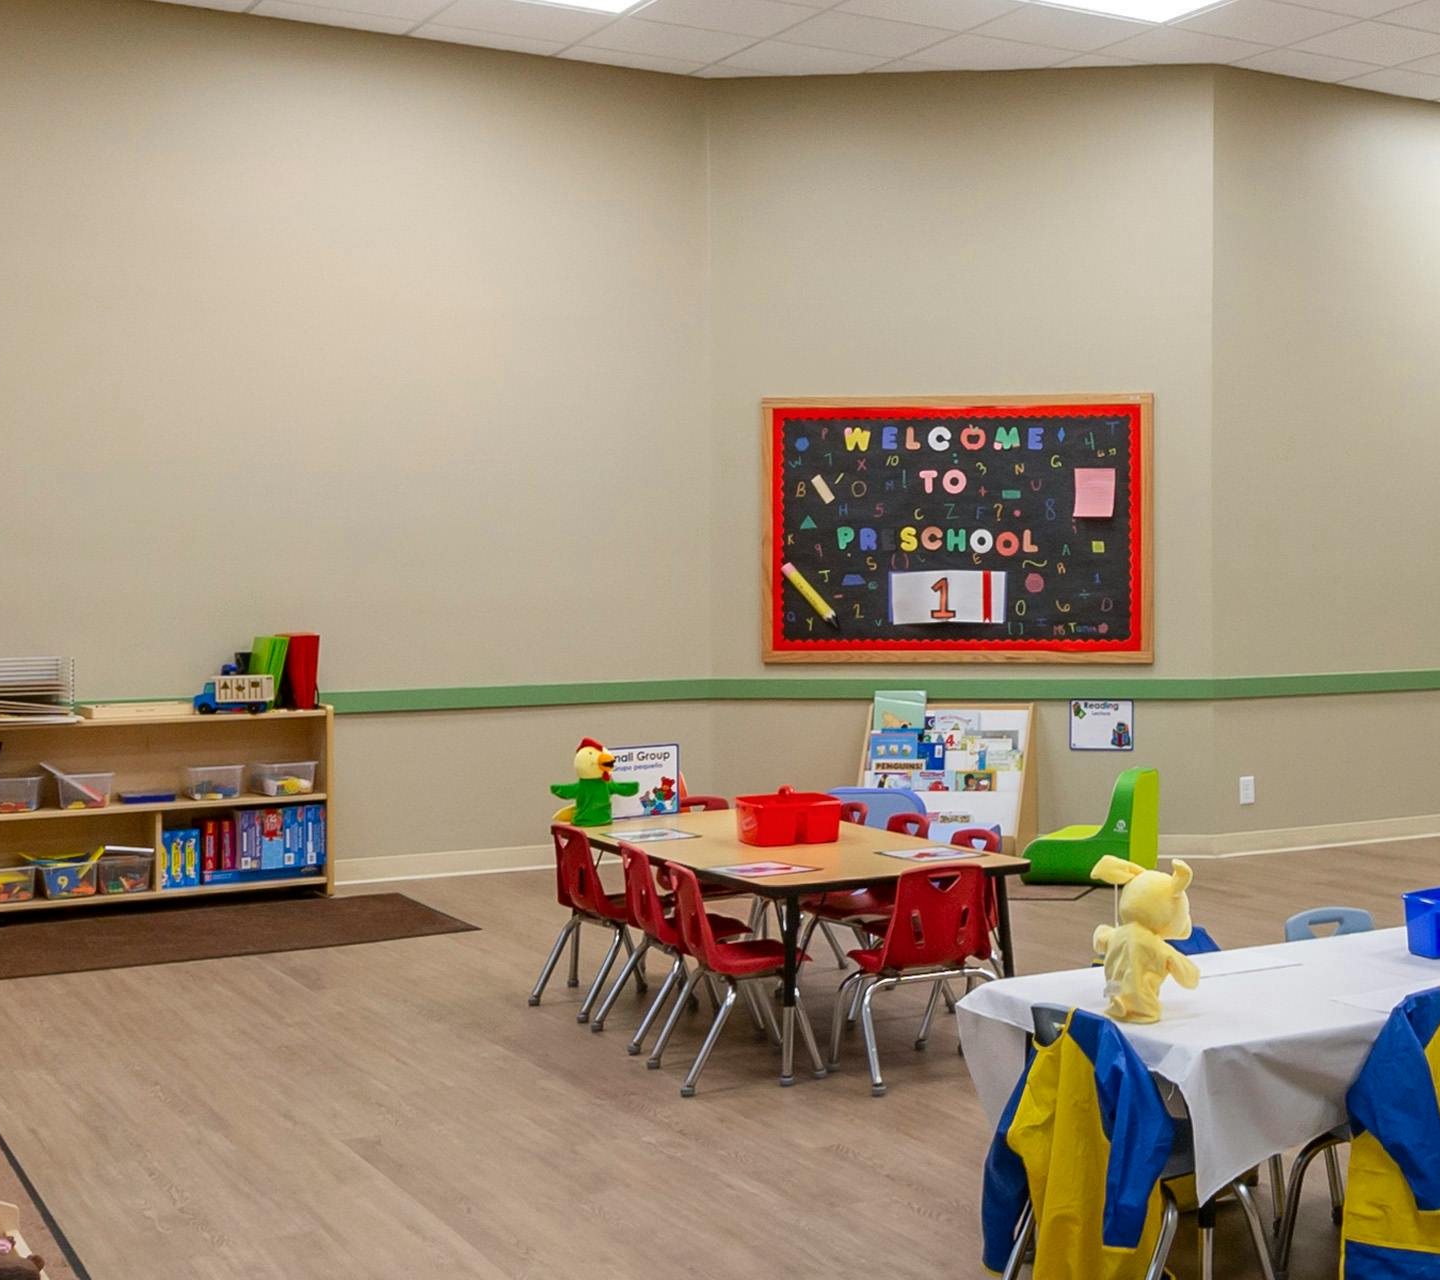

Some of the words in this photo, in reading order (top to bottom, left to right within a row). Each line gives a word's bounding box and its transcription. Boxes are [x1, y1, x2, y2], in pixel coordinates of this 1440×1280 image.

[843, 424, 1045, 452] WELCOME
[885, 455, 900, 467] 10
[918, 469, 968, 495] TO
[795, 481, 807, 498] B
[930, 577, 957, 620] 1
[1083, 701, 1120, 712] Reading
[636, 750, 671, 762] Group
[875, 762, 924, 770] PENGUINS!
